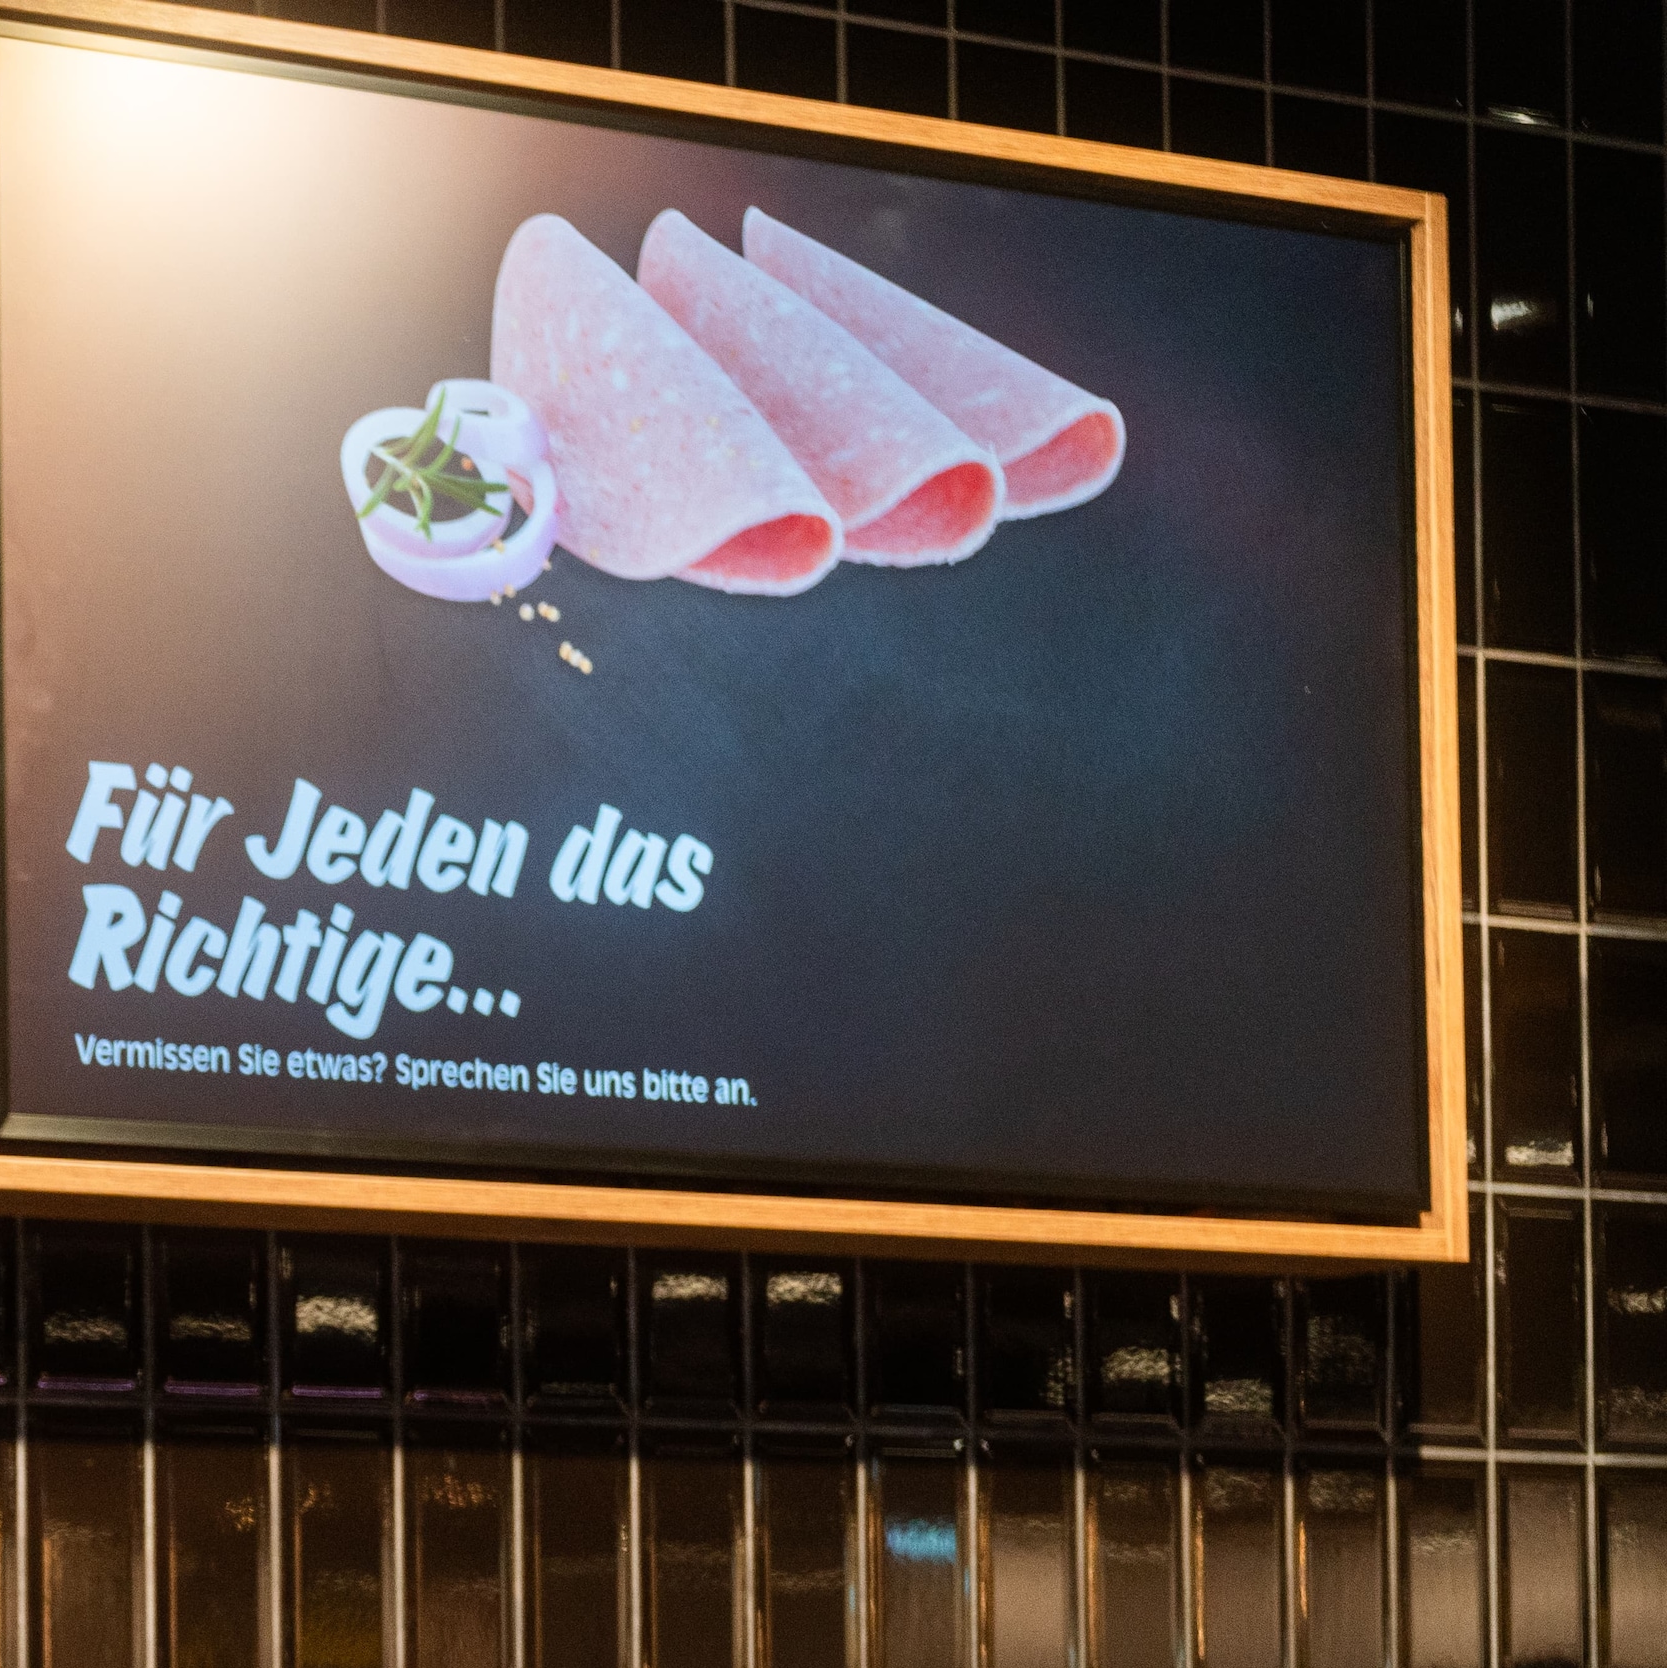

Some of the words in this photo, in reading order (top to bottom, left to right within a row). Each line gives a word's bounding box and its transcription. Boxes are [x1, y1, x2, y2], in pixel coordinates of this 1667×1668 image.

[65, 760, 234, 873] Für
[245, 777, 529, 899] Jeden
[548, 803, 713, 912] das
[67, 884, 522, 1040] Richtige...
[74, 1032, 230, 1074] Vermissen
[238, 1043, 281, 1077] Sie
[287, 1047, 388, 1084] etwas?
[395, 1053, 530, 1091] Sprechen
[536, 1061, 578, 1095] Sie
[583, 1068, 637, 1099] uns
[643, 1067, 709, 1103] bitte
[714, 1076, 758, 1107] an.
